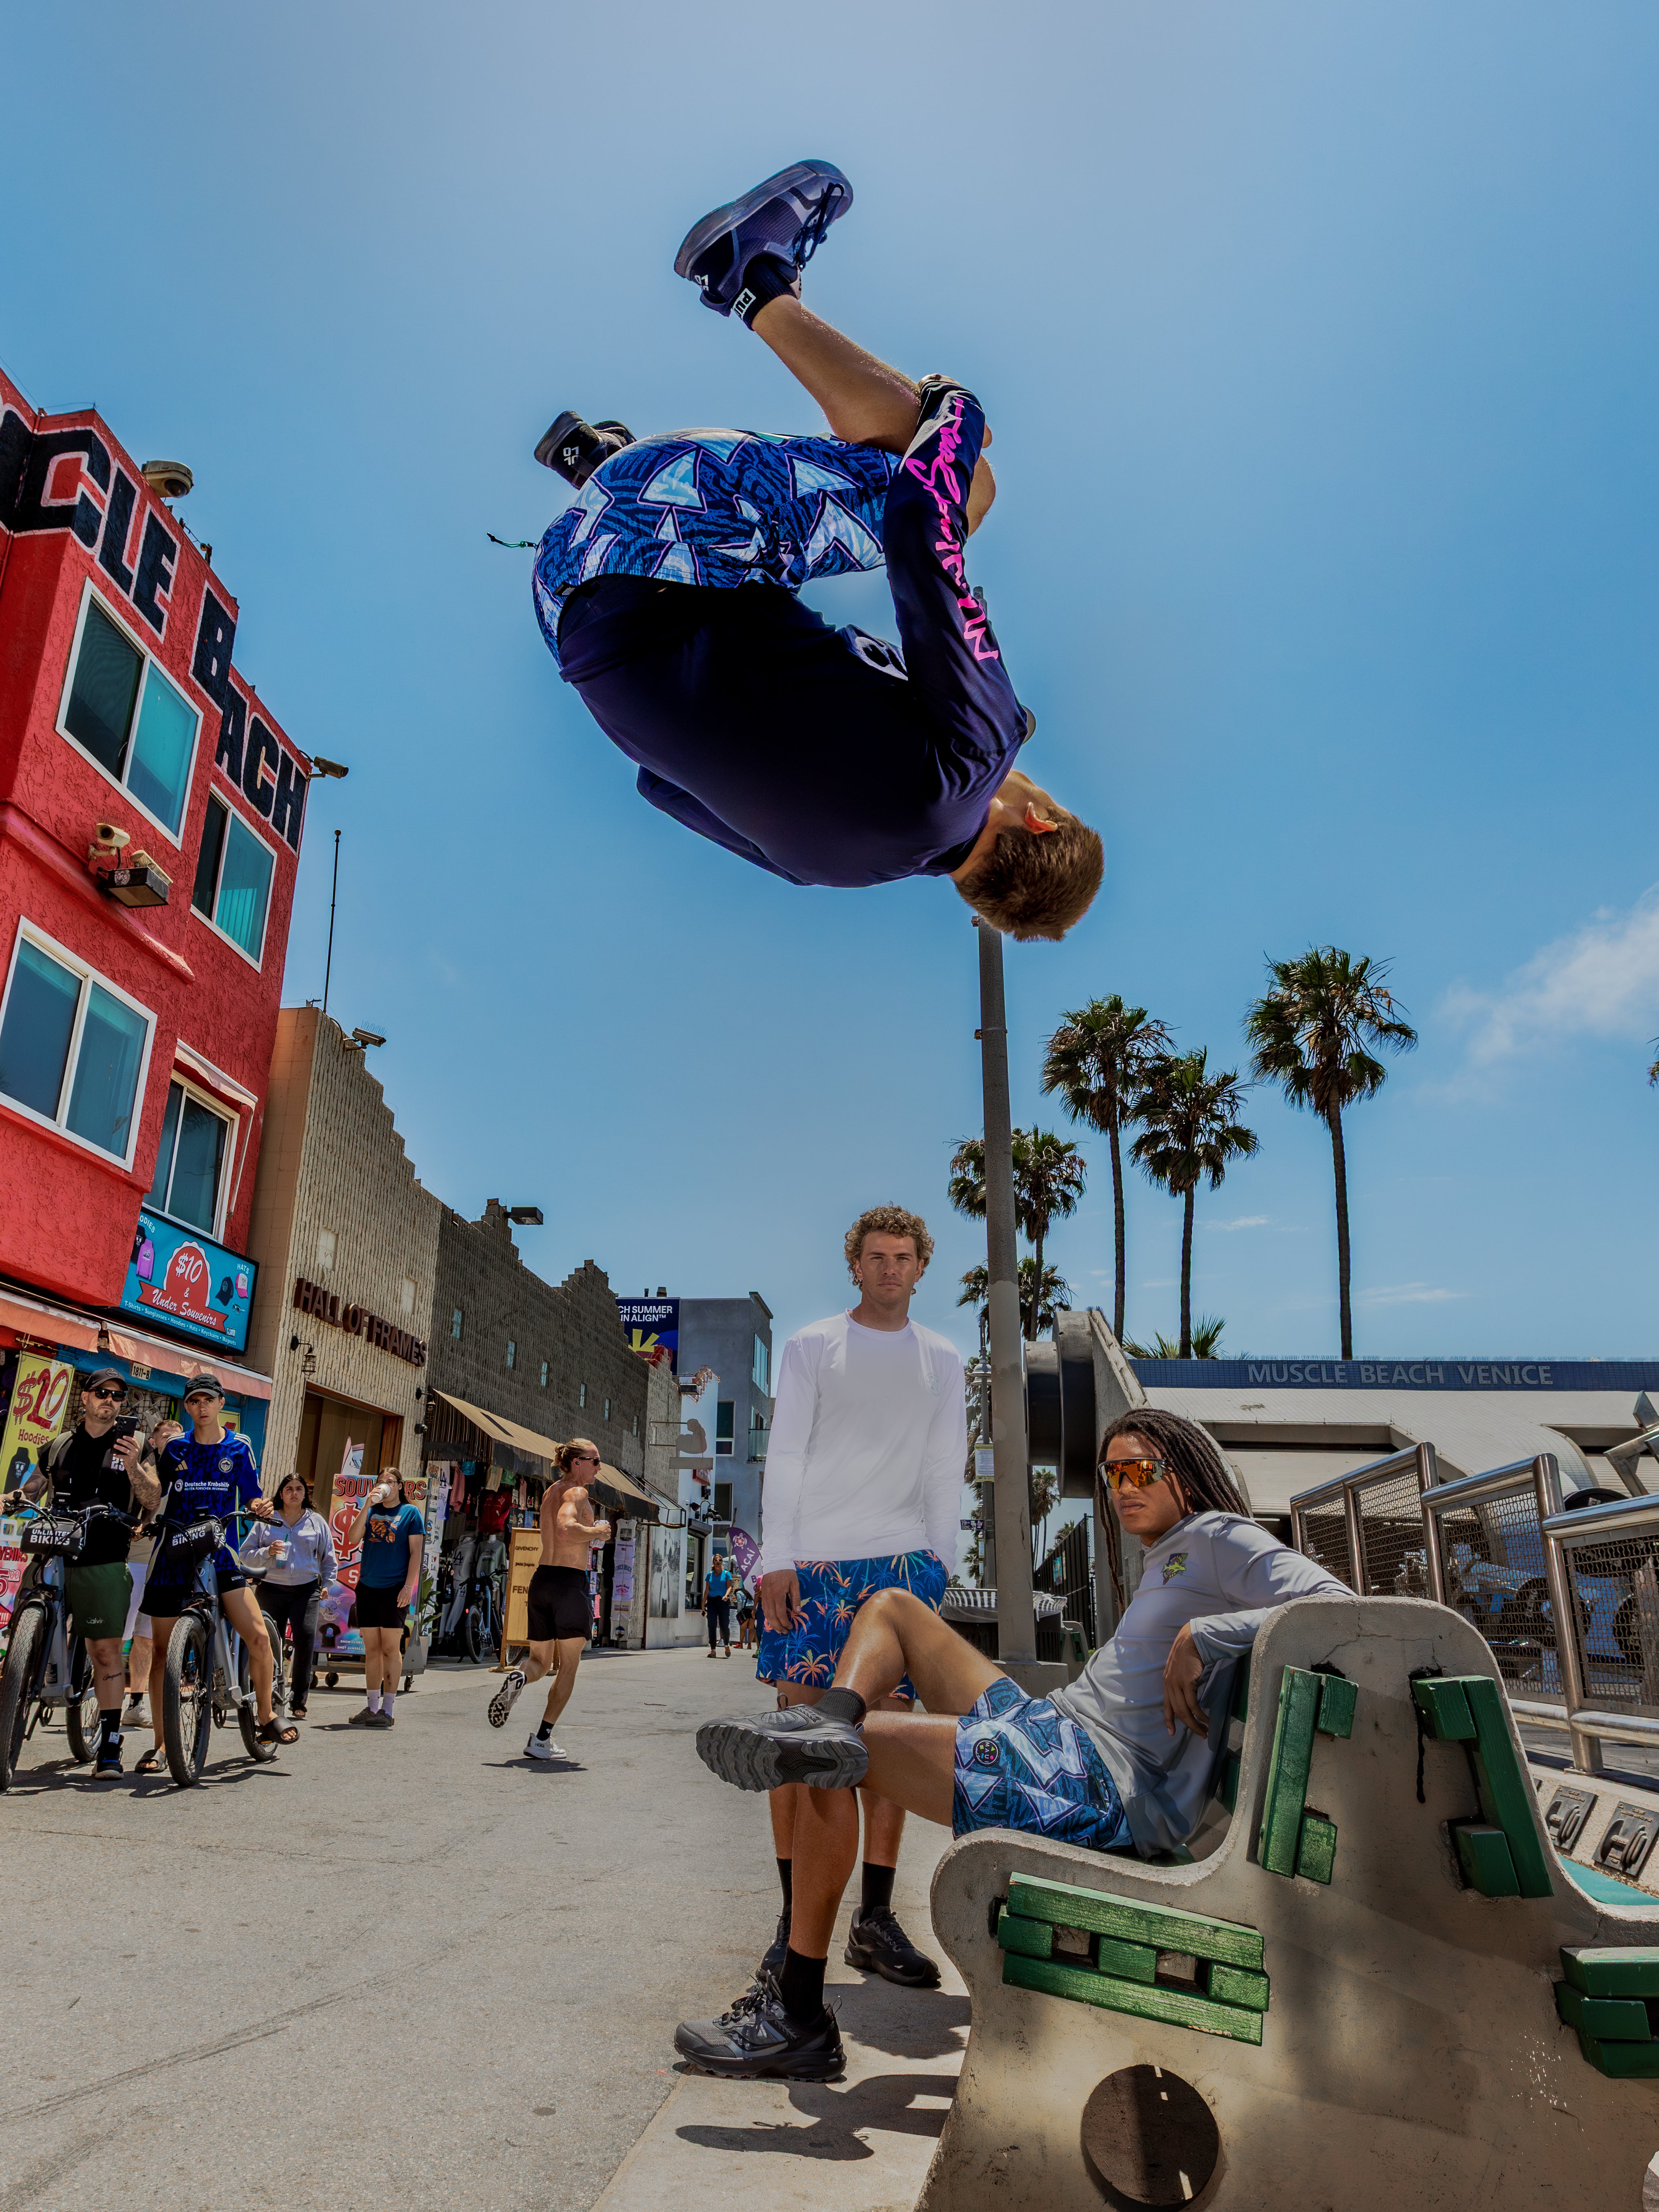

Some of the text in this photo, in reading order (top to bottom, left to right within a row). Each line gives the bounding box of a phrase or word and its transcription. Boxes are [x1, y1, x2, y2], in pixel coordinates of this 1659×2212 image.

[189, 581, 309, 856] BACH
[139, 1215, 156, 1234] ODIES
[175, 1253, 203, 1283] $10
[237, 1264, 249, 1274] HATS
[184, 1287, 190, 1298] &
[152, 1289, 217, 1326] Under Souvenirs
[125, 1300, 141, 1312] T-Shirts
[145, 1308, 167, 1321] Sunglasses
[171, 1319, 186, 1328] Hoodies
[189, 1324, 198, 1332] Hats
[201, 1328, 219, 1340] Keychains
[222, 1335, 237, 1346] Magnets
[293, 1278, 427, 1368] HALL OF FRAMES
[133, 1366, 150, 1380] 1811-B
[1247, 1364, 1554, 1385] MUSCLE BEACH VENICE
[18, 1429, 50, 1446] Hoodies
[741, 1547, 755, 1572] AÇAÍ
